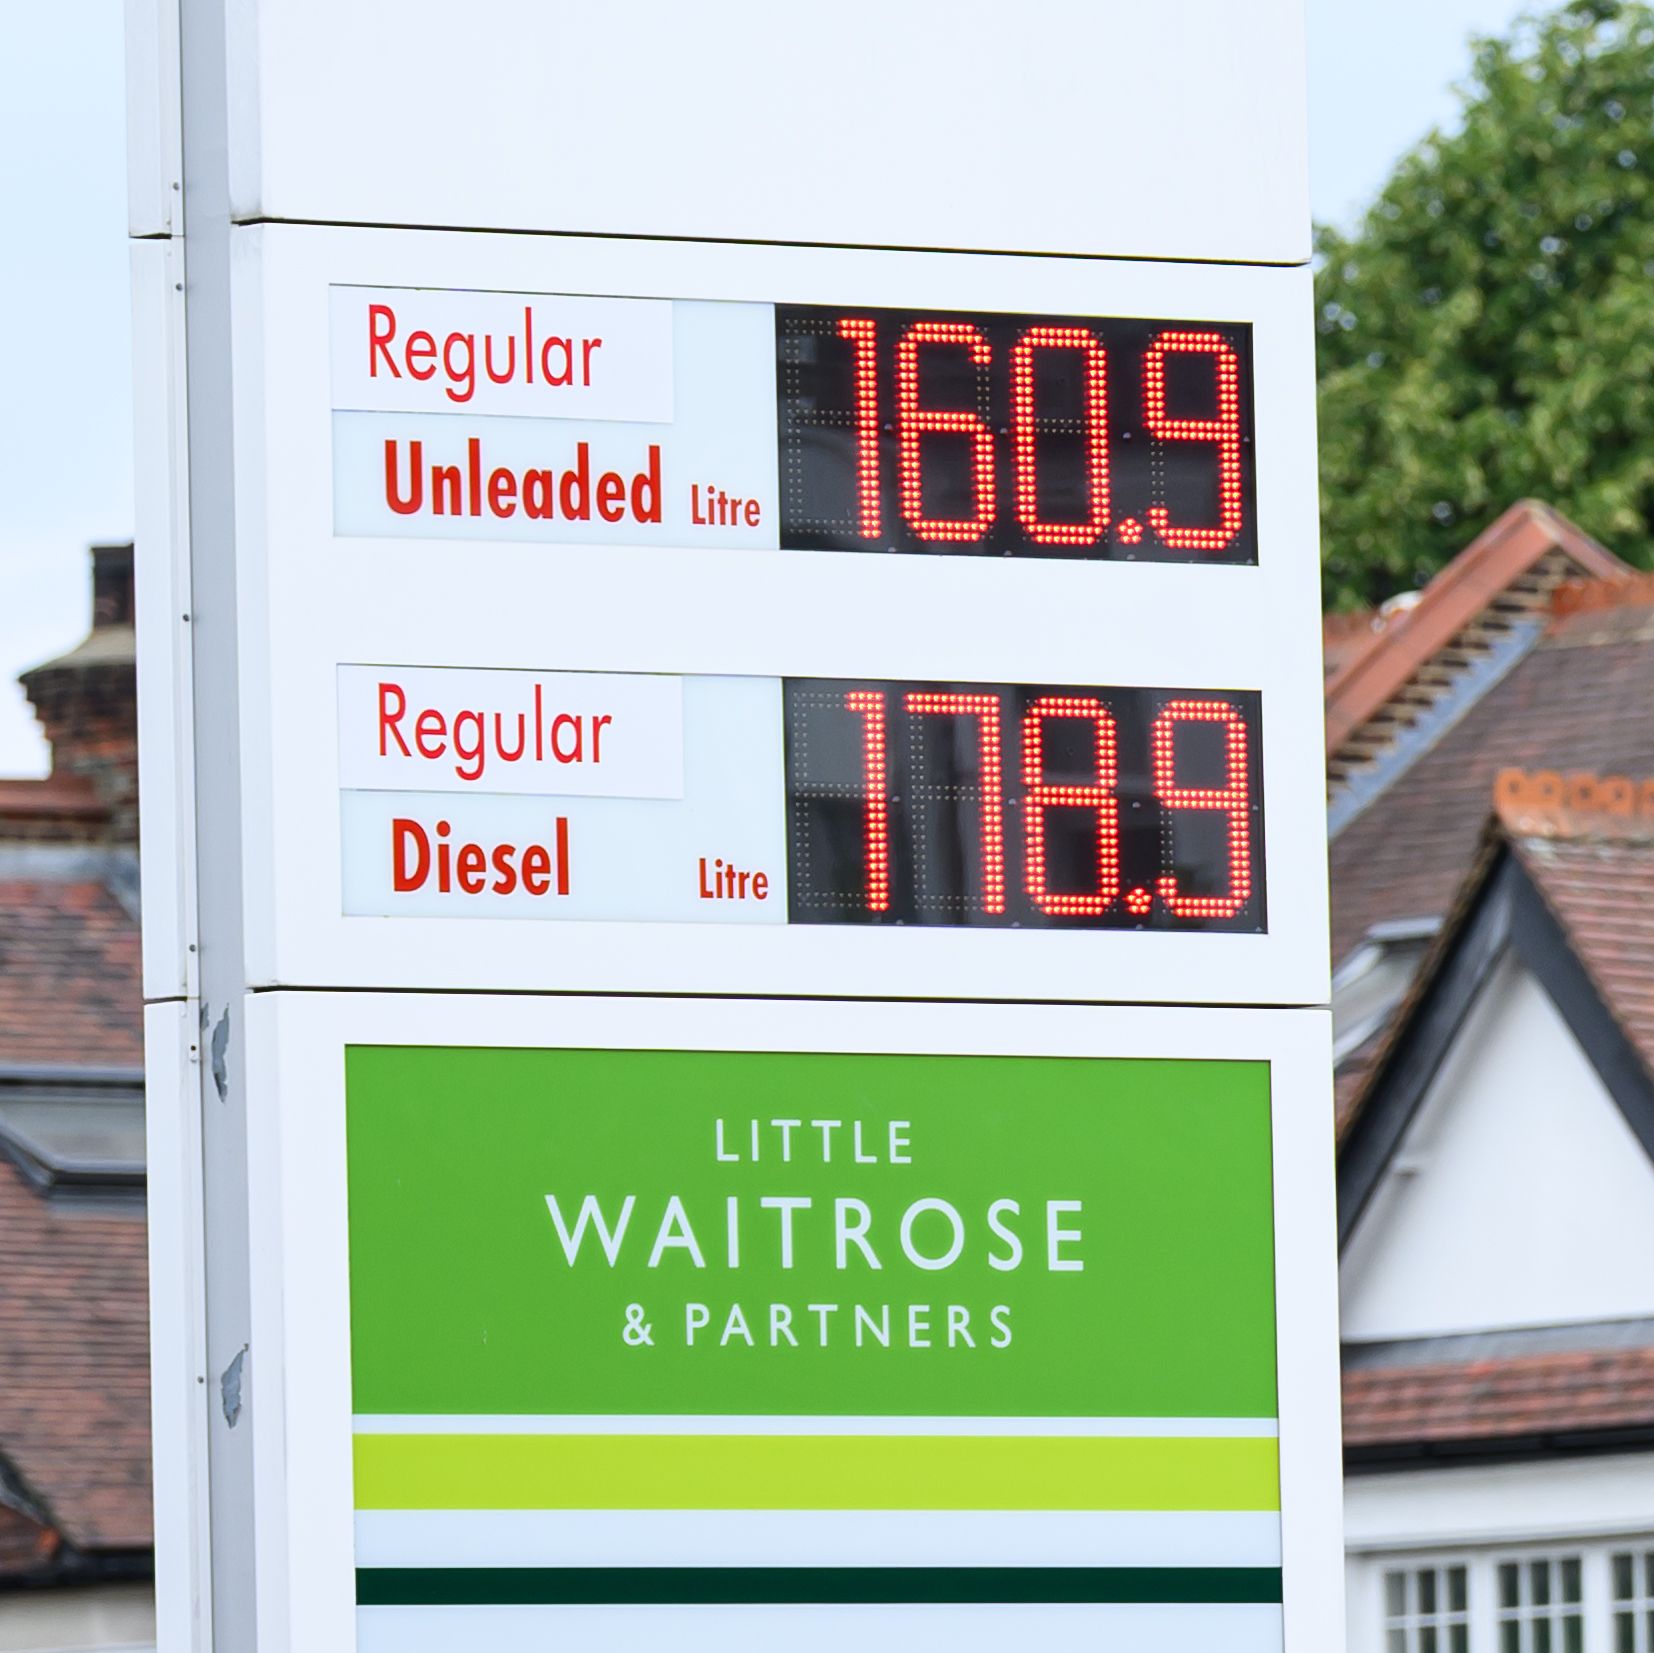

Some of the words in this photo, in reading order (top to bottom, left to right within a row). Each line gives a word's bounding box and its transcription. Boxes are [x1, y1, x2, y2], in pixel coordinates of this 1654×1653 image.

[368, 303, 603, 404] Regular
[836, 316, 1244, 552] 160.9
[384, 437, 662, 524] Unleaded
[691, 484, 761, 527] Litre
[377, 682, 613, 782] Regular
[846, 690, 1252, 919] 178.9
[392, 816, 570, 896] Diesel
[699, 857, 768, 900] Litre
[716, 1118, 912, 1164] LITTLE
[544, 1194, 1085, 1272] WAITROSE
[622, 1303, 655, 1346] &
[685, 1303, 1013, 1349] PARTNERS
